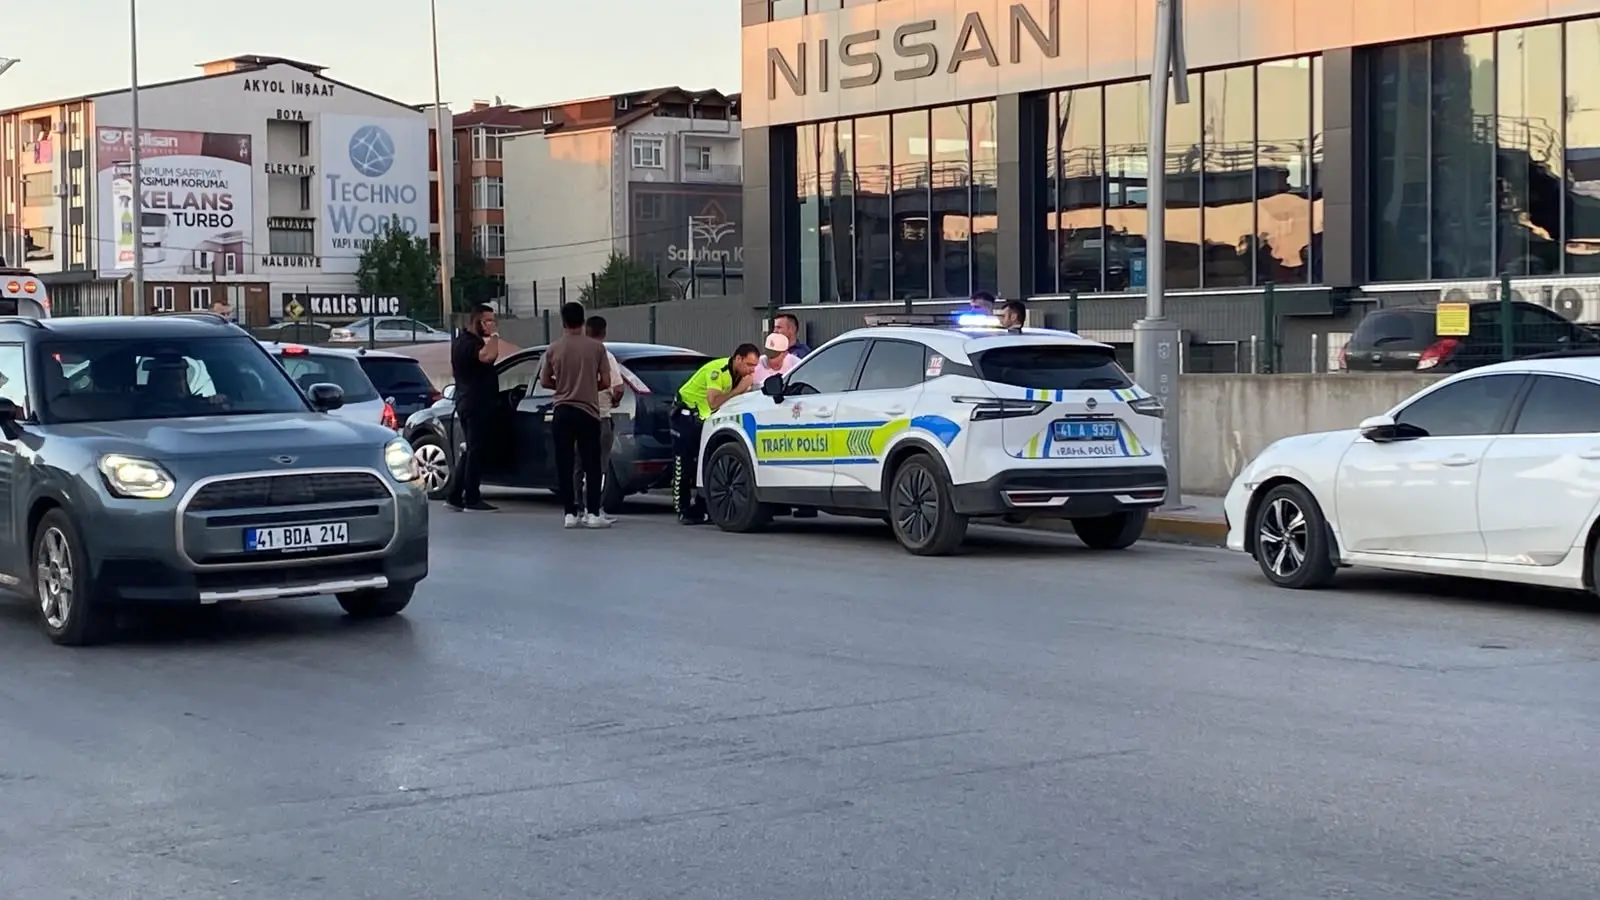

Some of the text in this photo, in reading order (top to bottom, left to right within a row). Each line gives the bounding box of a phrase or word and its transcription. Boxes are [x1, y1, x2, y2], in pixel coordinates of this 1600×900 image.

[767, 0, 1060, 100] NISSAN
[243, 79, 335, 97] AKYOL İNŞAAT
[276, 108, 304, 121] BOYA
[139, 175, 229, 190] KSİMUM KORUMA!
[140, 191, 234, 211] ELANS
[173, 212, 234, 228] TURBO
[327, 204, 418, 236] WORD
[331, 238, 351, 249] YAPI
[667, 244, 730, 262] Sauhan
[310, 294, 400, 316] KALİS VİNÇ
[1061, 424, 1071, 437] 41
[1079, 424, 1086, 437] A
[761, 432, 829, 453] TRAFİK POLİSİ
[1088, 443, 1117, 455] POLİSİ
[257, 524, 346, 548] 41 BDA 214
